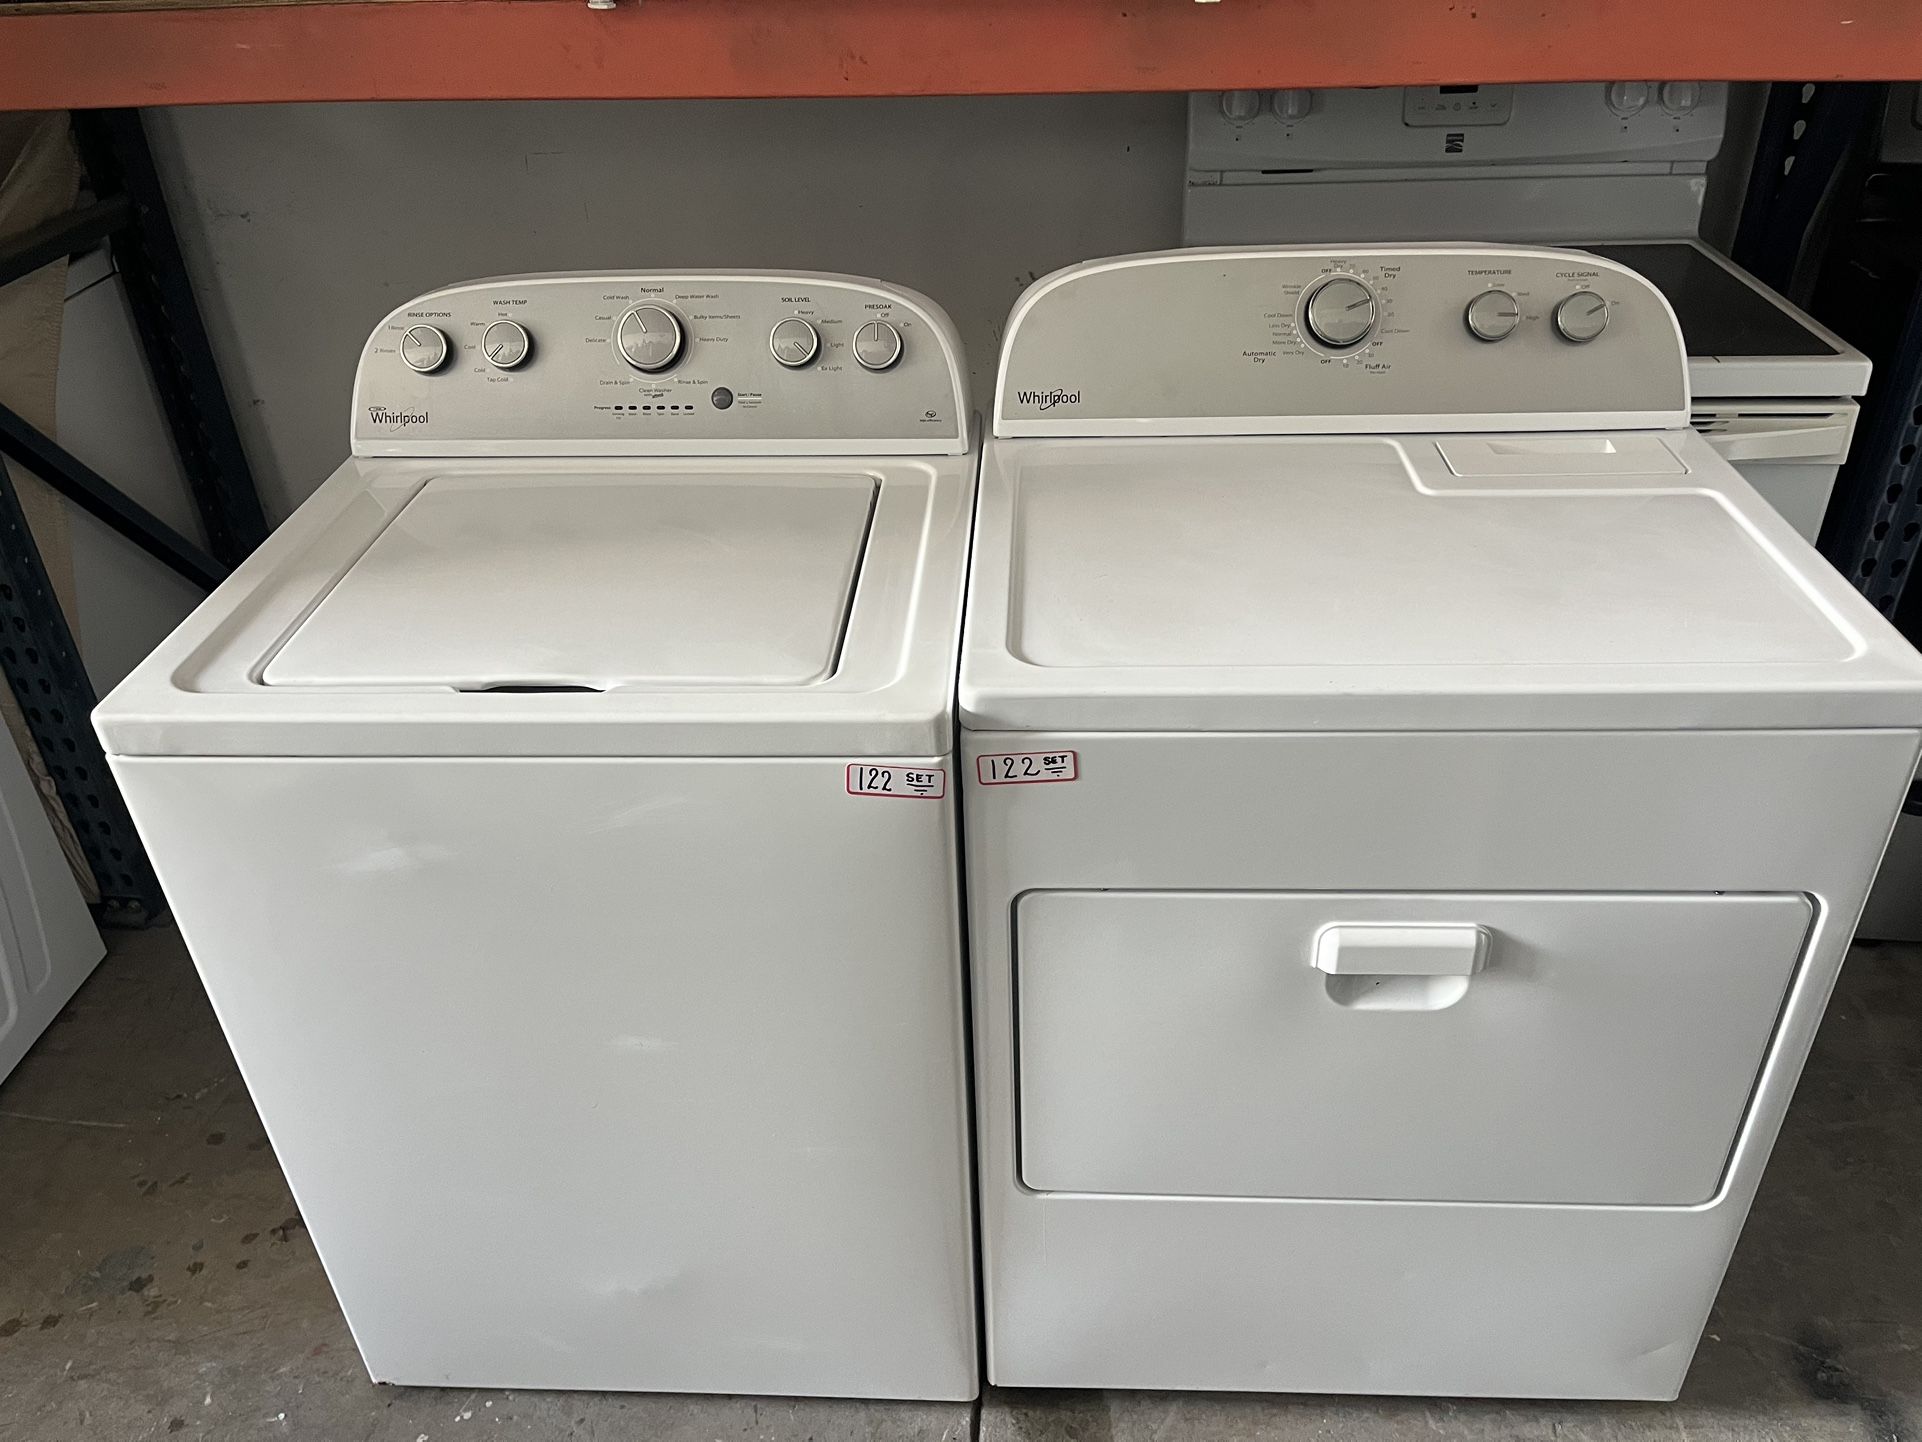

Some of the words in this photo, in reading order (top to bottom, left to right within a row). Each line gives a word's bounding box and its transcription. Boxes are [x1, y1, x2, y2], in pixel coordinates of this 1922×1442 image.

[715, 336, 729, 344] Duty
[1017, 390, 1081, 407] Whirlpool
[370, 411, 429, 427] Whirlpool
[990, 756, 1041, 780] 122
[1043, 754, 1068, 766] SET
[858, 766, 892, 792] 122
[905, 772, 935, 784] SET
